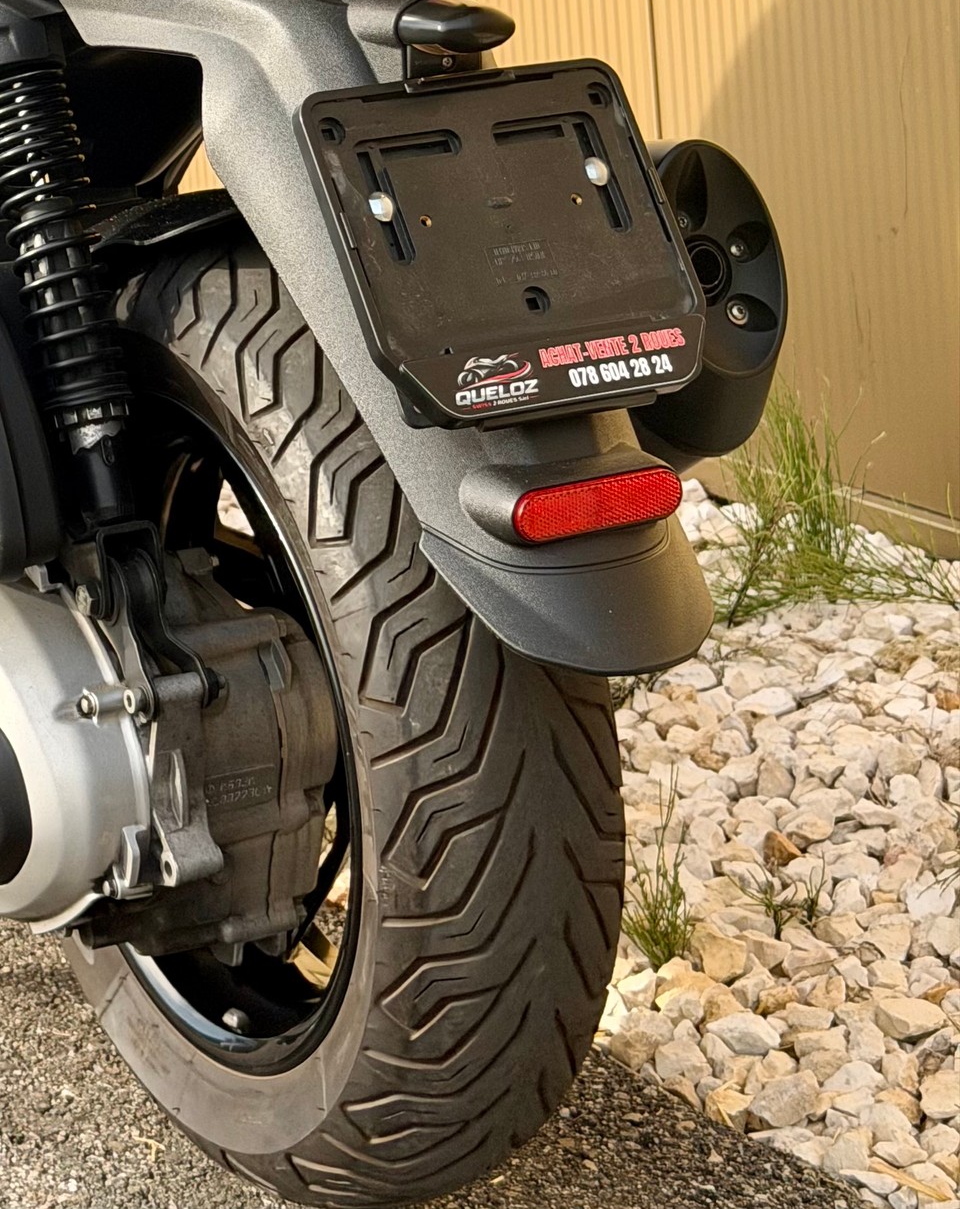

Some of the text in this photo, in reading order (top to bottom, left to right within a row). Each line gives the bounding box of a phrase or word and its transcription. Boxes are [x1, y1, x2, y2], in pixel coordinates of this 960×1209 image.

[539, 328, 686, 368] ACHAT-VENTE 2 ROUES
[568, 353, 674, 388] 078 604 28 24
[455, 378, 539, 406] QUELOZ
